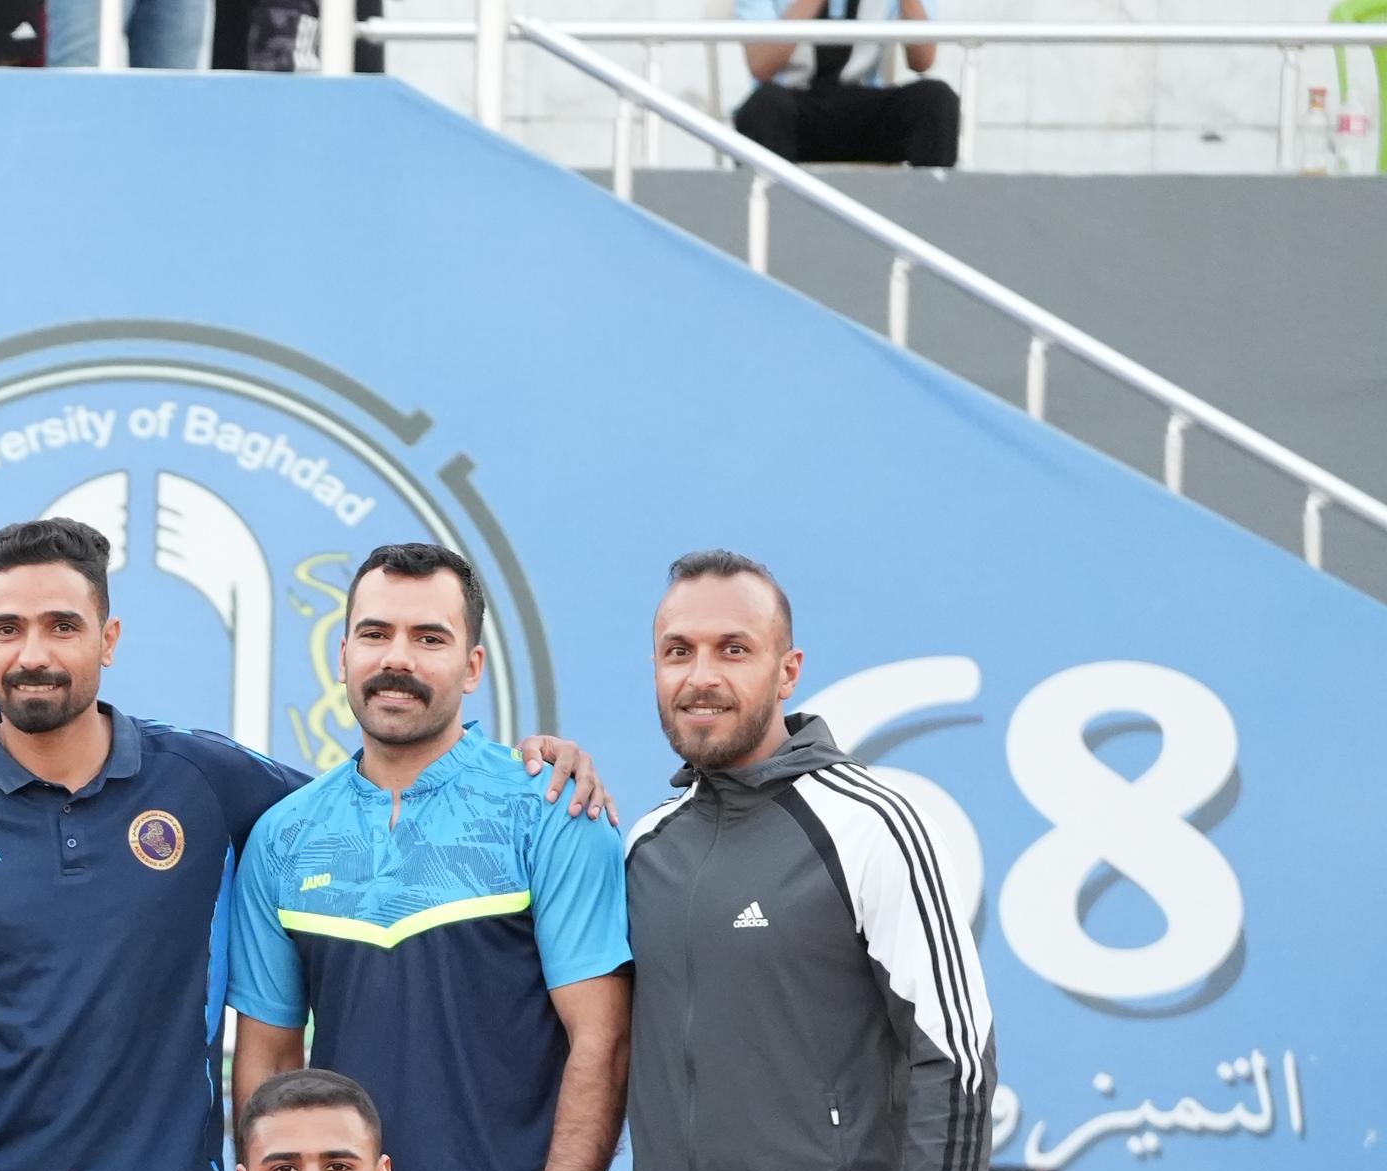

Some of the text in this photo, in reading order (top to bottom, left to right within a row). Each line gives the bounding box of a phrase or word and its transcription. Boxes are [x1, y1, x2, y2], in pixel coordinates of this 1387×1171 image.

[128, 401, 177, 440] of
[184, 404, 376, 527] Baghdad
[733, 917, 769, 928] adidas
[1025, 1048, 1304, 1170] التميز
